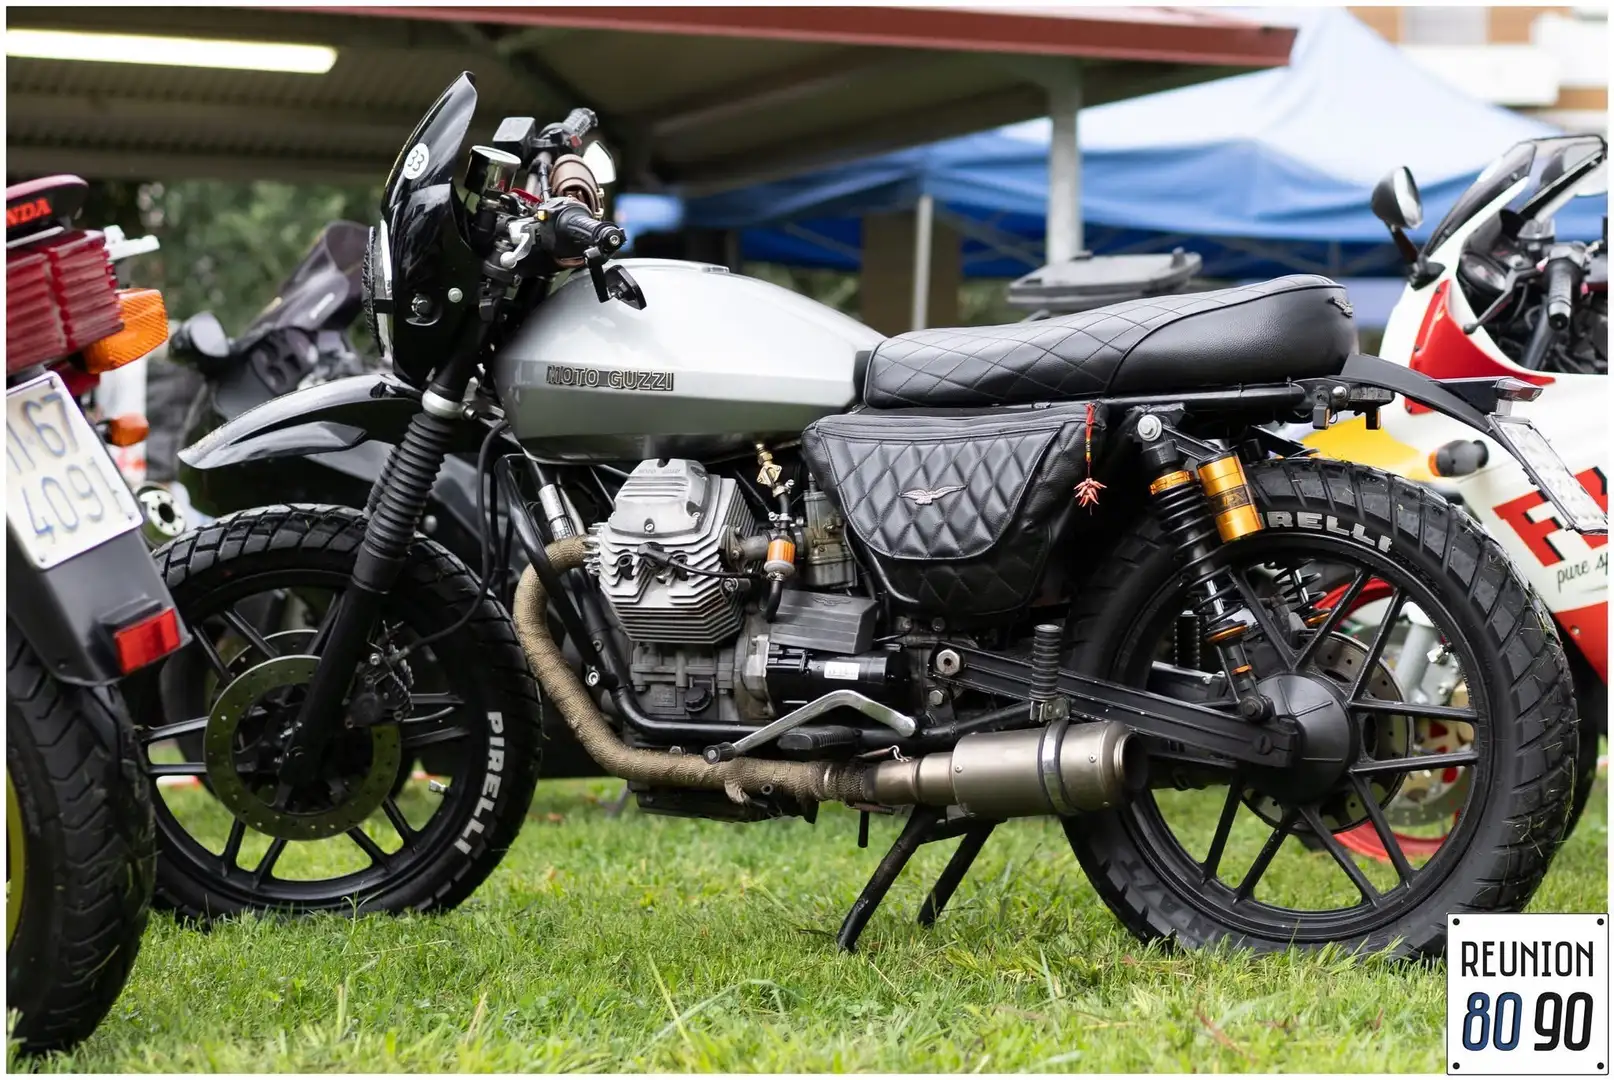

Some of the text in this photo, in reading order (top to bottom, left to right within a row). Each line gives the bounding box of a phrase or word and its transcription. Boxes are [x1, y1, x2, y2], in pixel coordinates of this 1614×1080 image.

[407, 149, 425, 172] 33
[546, 364, 675, 392] MOTO GUZZI
[1257, 511, 1393, 553] RELLI
[1556, 560, 1591, 594] pure
[454, 711, 506, 856] PIRELLI
